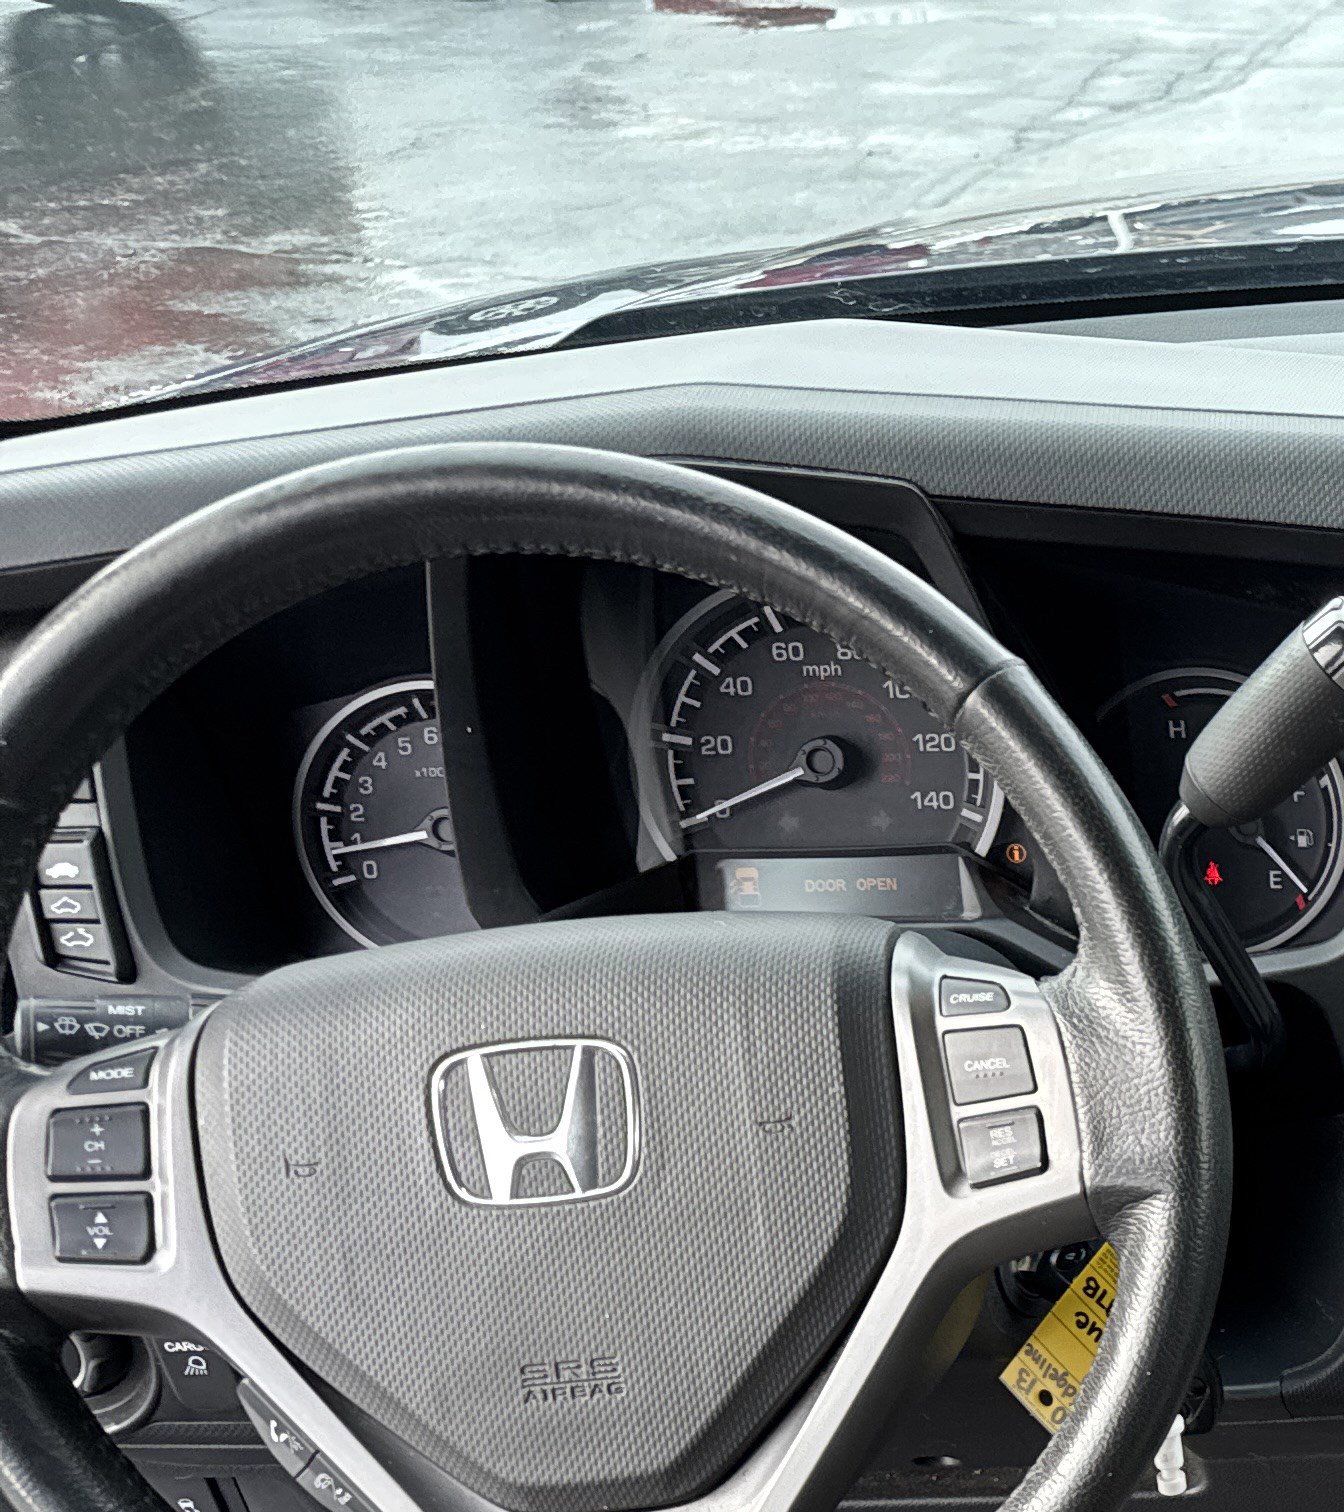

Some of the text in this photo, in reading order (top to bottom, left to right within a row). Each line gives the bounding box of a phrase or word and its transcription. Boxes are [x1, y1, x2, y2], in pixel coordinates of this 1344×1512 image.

[772, 642, 804, 661] 60
[803, 661, 842, 681] mph
[719, 676, 753, 696] 40
[883, 680, 911, 698] 10
[423, 727, 438, 744] 6
[1169, 721, 1185, 738] H
[397, 738, 413, 755] 5
[701, 735, 733, 755] 20
[912, 733, 956, 752] 120
[373, 752, 388, 769] 4
[358, 777, 373, 794] 3
[910, 791, 954, 810] 140
[350, 804, 365, 822] 2
[362, 860, 378, 879] 0
[804, 877, 898, 893] DOOR OPEN
[1269, 871, 1283, 890] E
[950, 991, 994, 1004] CRUISE
[107, 1005, 146, 1016] MIST
[113, 1024, 146, 1037] OFF
[964, 1058, 1011, 1072] CANCEL
[89, 1067, 135, 1081] MODE
[83, 1141, 105, 1152] CH
[993, 1155, 1015, 1168] SET
[86, 1225, 113, 1236] VOL
[163, 1341, 209, 1353] CAR
[520, 1356, 623, 1383] SRS
[523, 1381, 626, 1404] AIRBAG
